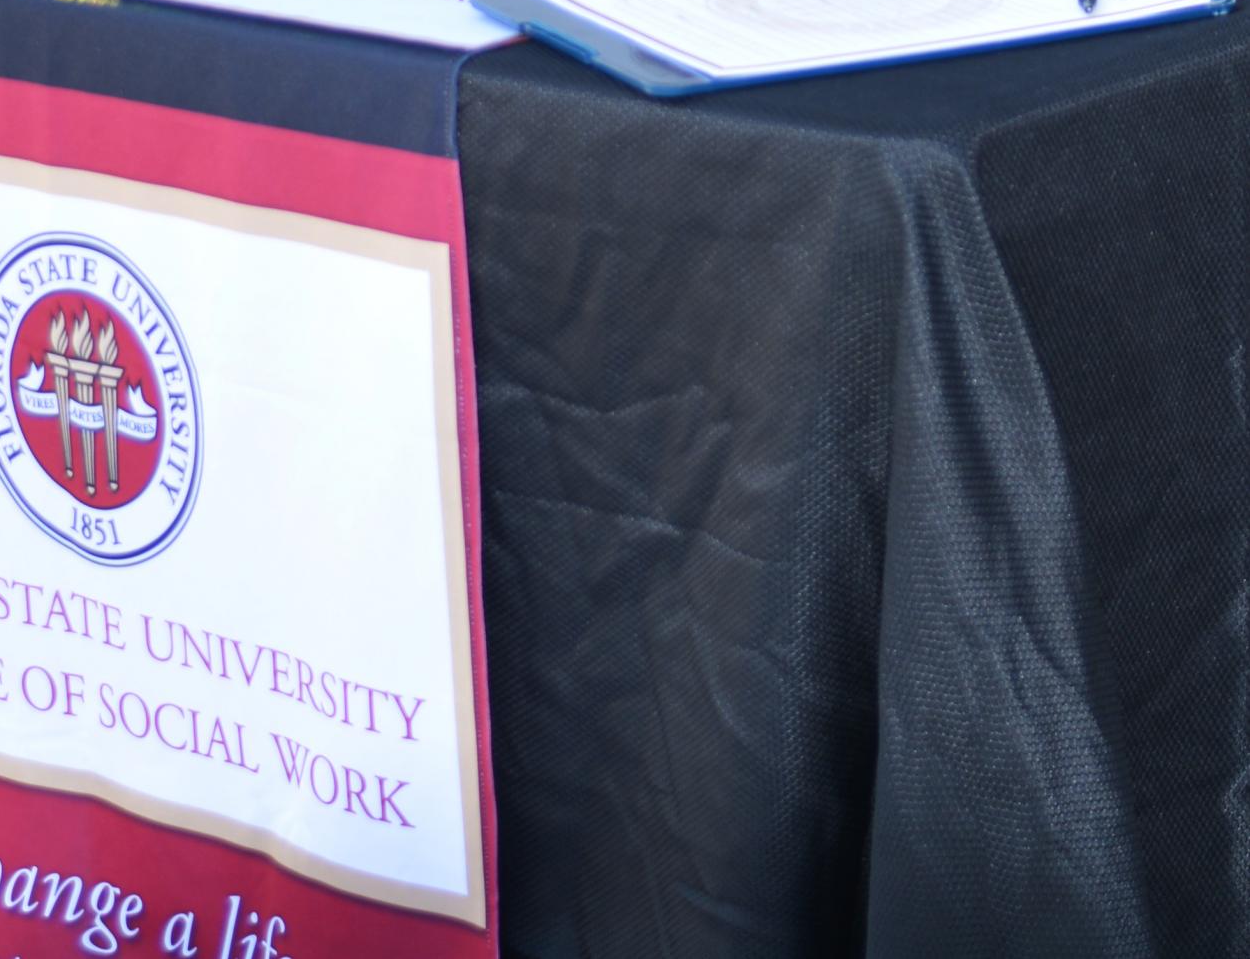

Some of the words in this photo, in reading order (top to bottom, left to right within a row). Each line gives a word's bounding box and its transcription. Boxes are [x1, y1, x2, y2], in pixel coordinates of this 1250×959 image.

[18, 253, 98, 297] STATE
[111, 270, 191, 505] UNIVERSITY
[24, 394, 56, 410] VIRES
[69, 406, 105, 424] ARTES
[119, 415, 156, 435] MORES
[69, 506, 122, 546] 1851
[139, 613, 426, 742] UNIVERSITY
[20, 664, 86, 717] OF
[97, 681, 261, 775] SOCIAL
[267, 731, 417, 829] WORK
[162, 910, 197, 956] a
[219, 894, 292, 959] lif
